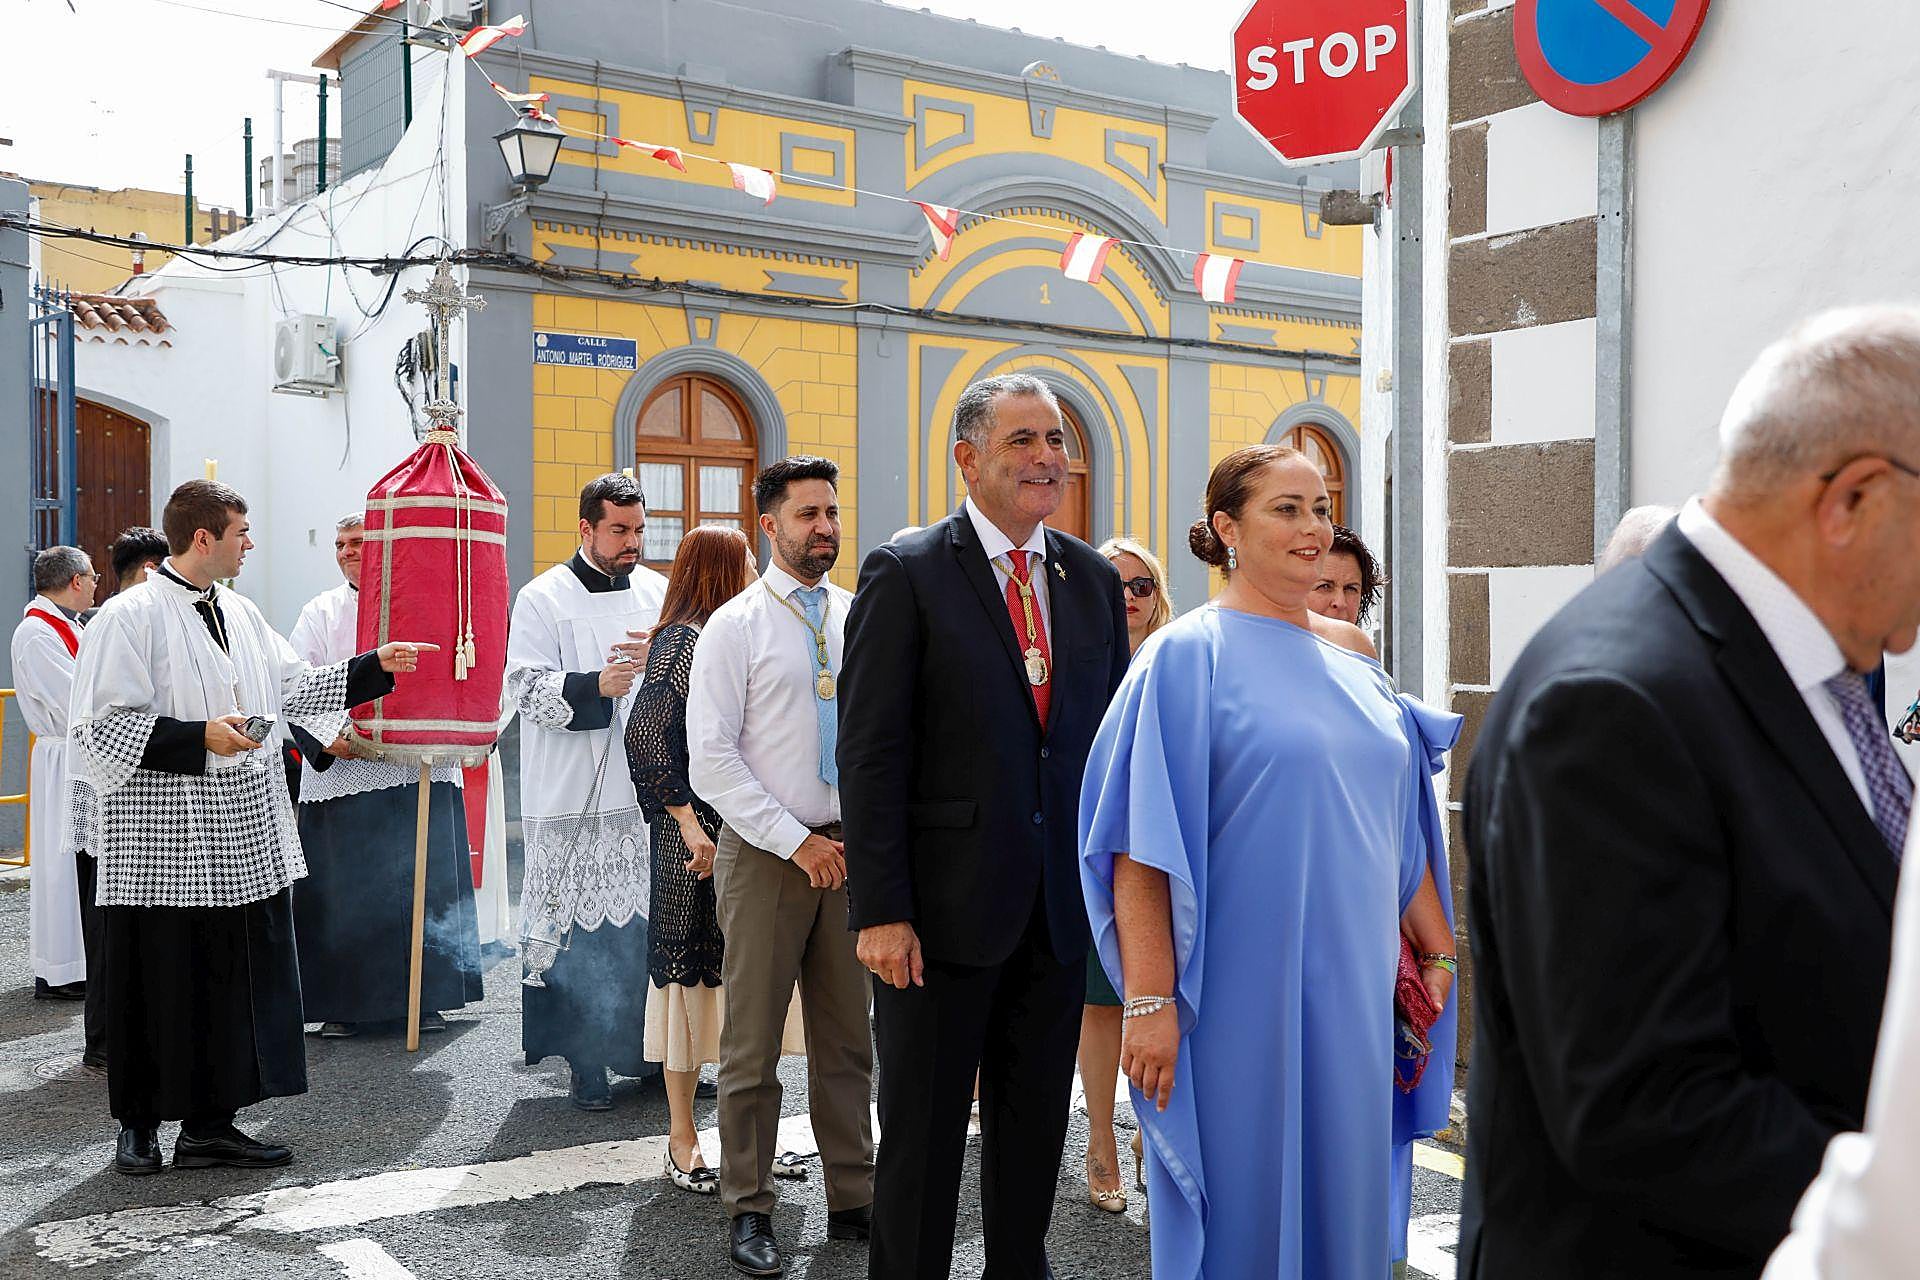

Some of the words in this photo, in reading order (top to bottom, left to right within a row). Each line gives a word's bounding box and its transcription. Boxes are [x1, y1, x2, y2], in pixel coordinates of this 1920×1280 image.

[1246, 25, 1397, 91] STOP
[1040, 281, 1051, 304] 1
[578, 337, 607, 347] CALLE
[536, 350, 566, 363] ANTONIO
[569, 352, 594, 365] MARTEL
[597, 354, 634, 368] RODRIGUEZ
